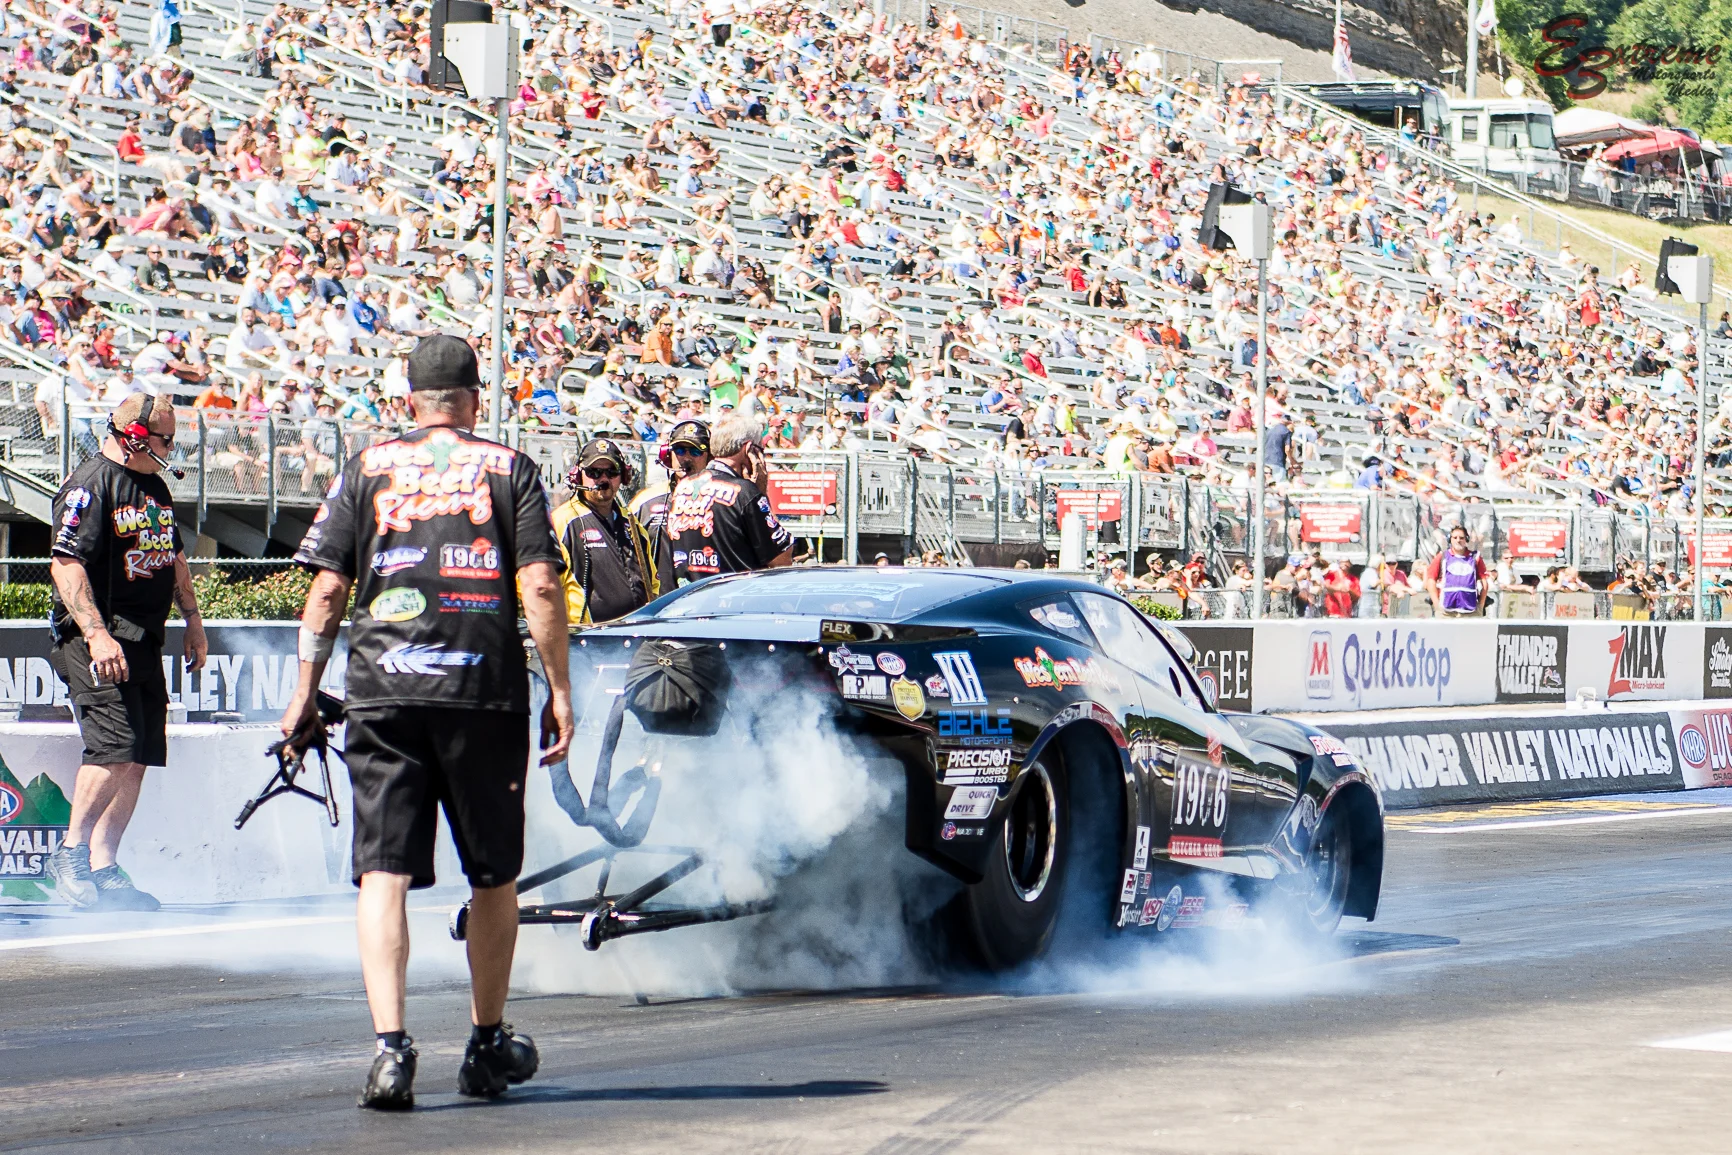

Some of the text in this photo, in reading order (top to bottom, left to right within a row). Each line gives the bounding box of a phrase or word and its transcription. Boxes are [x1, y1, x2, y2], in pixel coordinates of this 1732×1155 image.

[395, 465, 476, 496] Beef
[675, 476, 737, 504] estern
[127, 551, 178, 580] Racin
[822, 622, 852, 635] FLEX
[1498, 634, 1558, 667] THUNDER
[1498, 668, 1544, 694] VALLEY
[960, 736, 1013, 746] MOTORSPORTS
[1681, 731, 1706, 762] NHRA
[947, 749, 1011, 768] PRECISION
[1461, 728, 1552, 784] VALLEY
[1553, 724, 1674, 781] NATIONALS
[974, 776, 1007, 784] BOOSTED
[977, 767, 1009, 776] TURBO
[968, 791, 992, 799] QUICK
[950, 804, 976, 813] DRIVE
